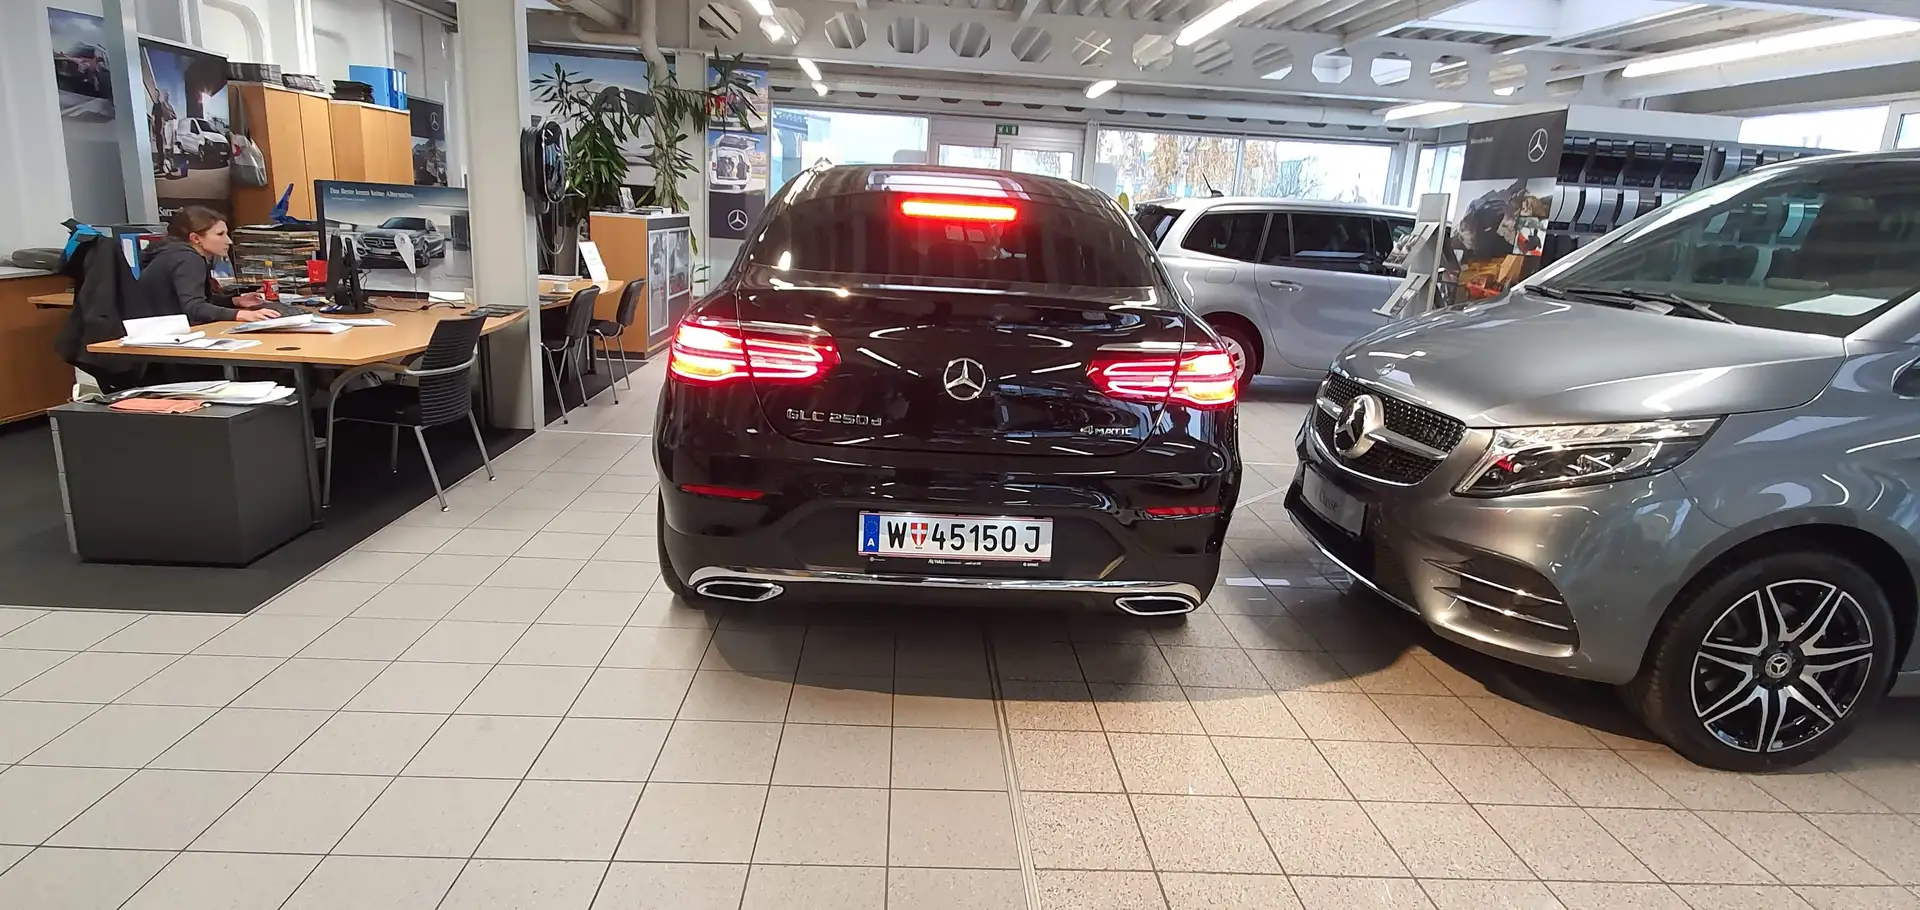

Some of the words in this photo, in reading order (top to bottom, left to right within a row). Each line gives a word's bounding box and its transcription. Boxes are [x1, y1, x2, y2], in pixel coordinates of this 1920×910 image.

[786, 408, 825, 422] GLC
[1080, 425, 1133, 435] 4MATIC
[887, 521, 908, 549] W
[867, 537, 876, 547] A
